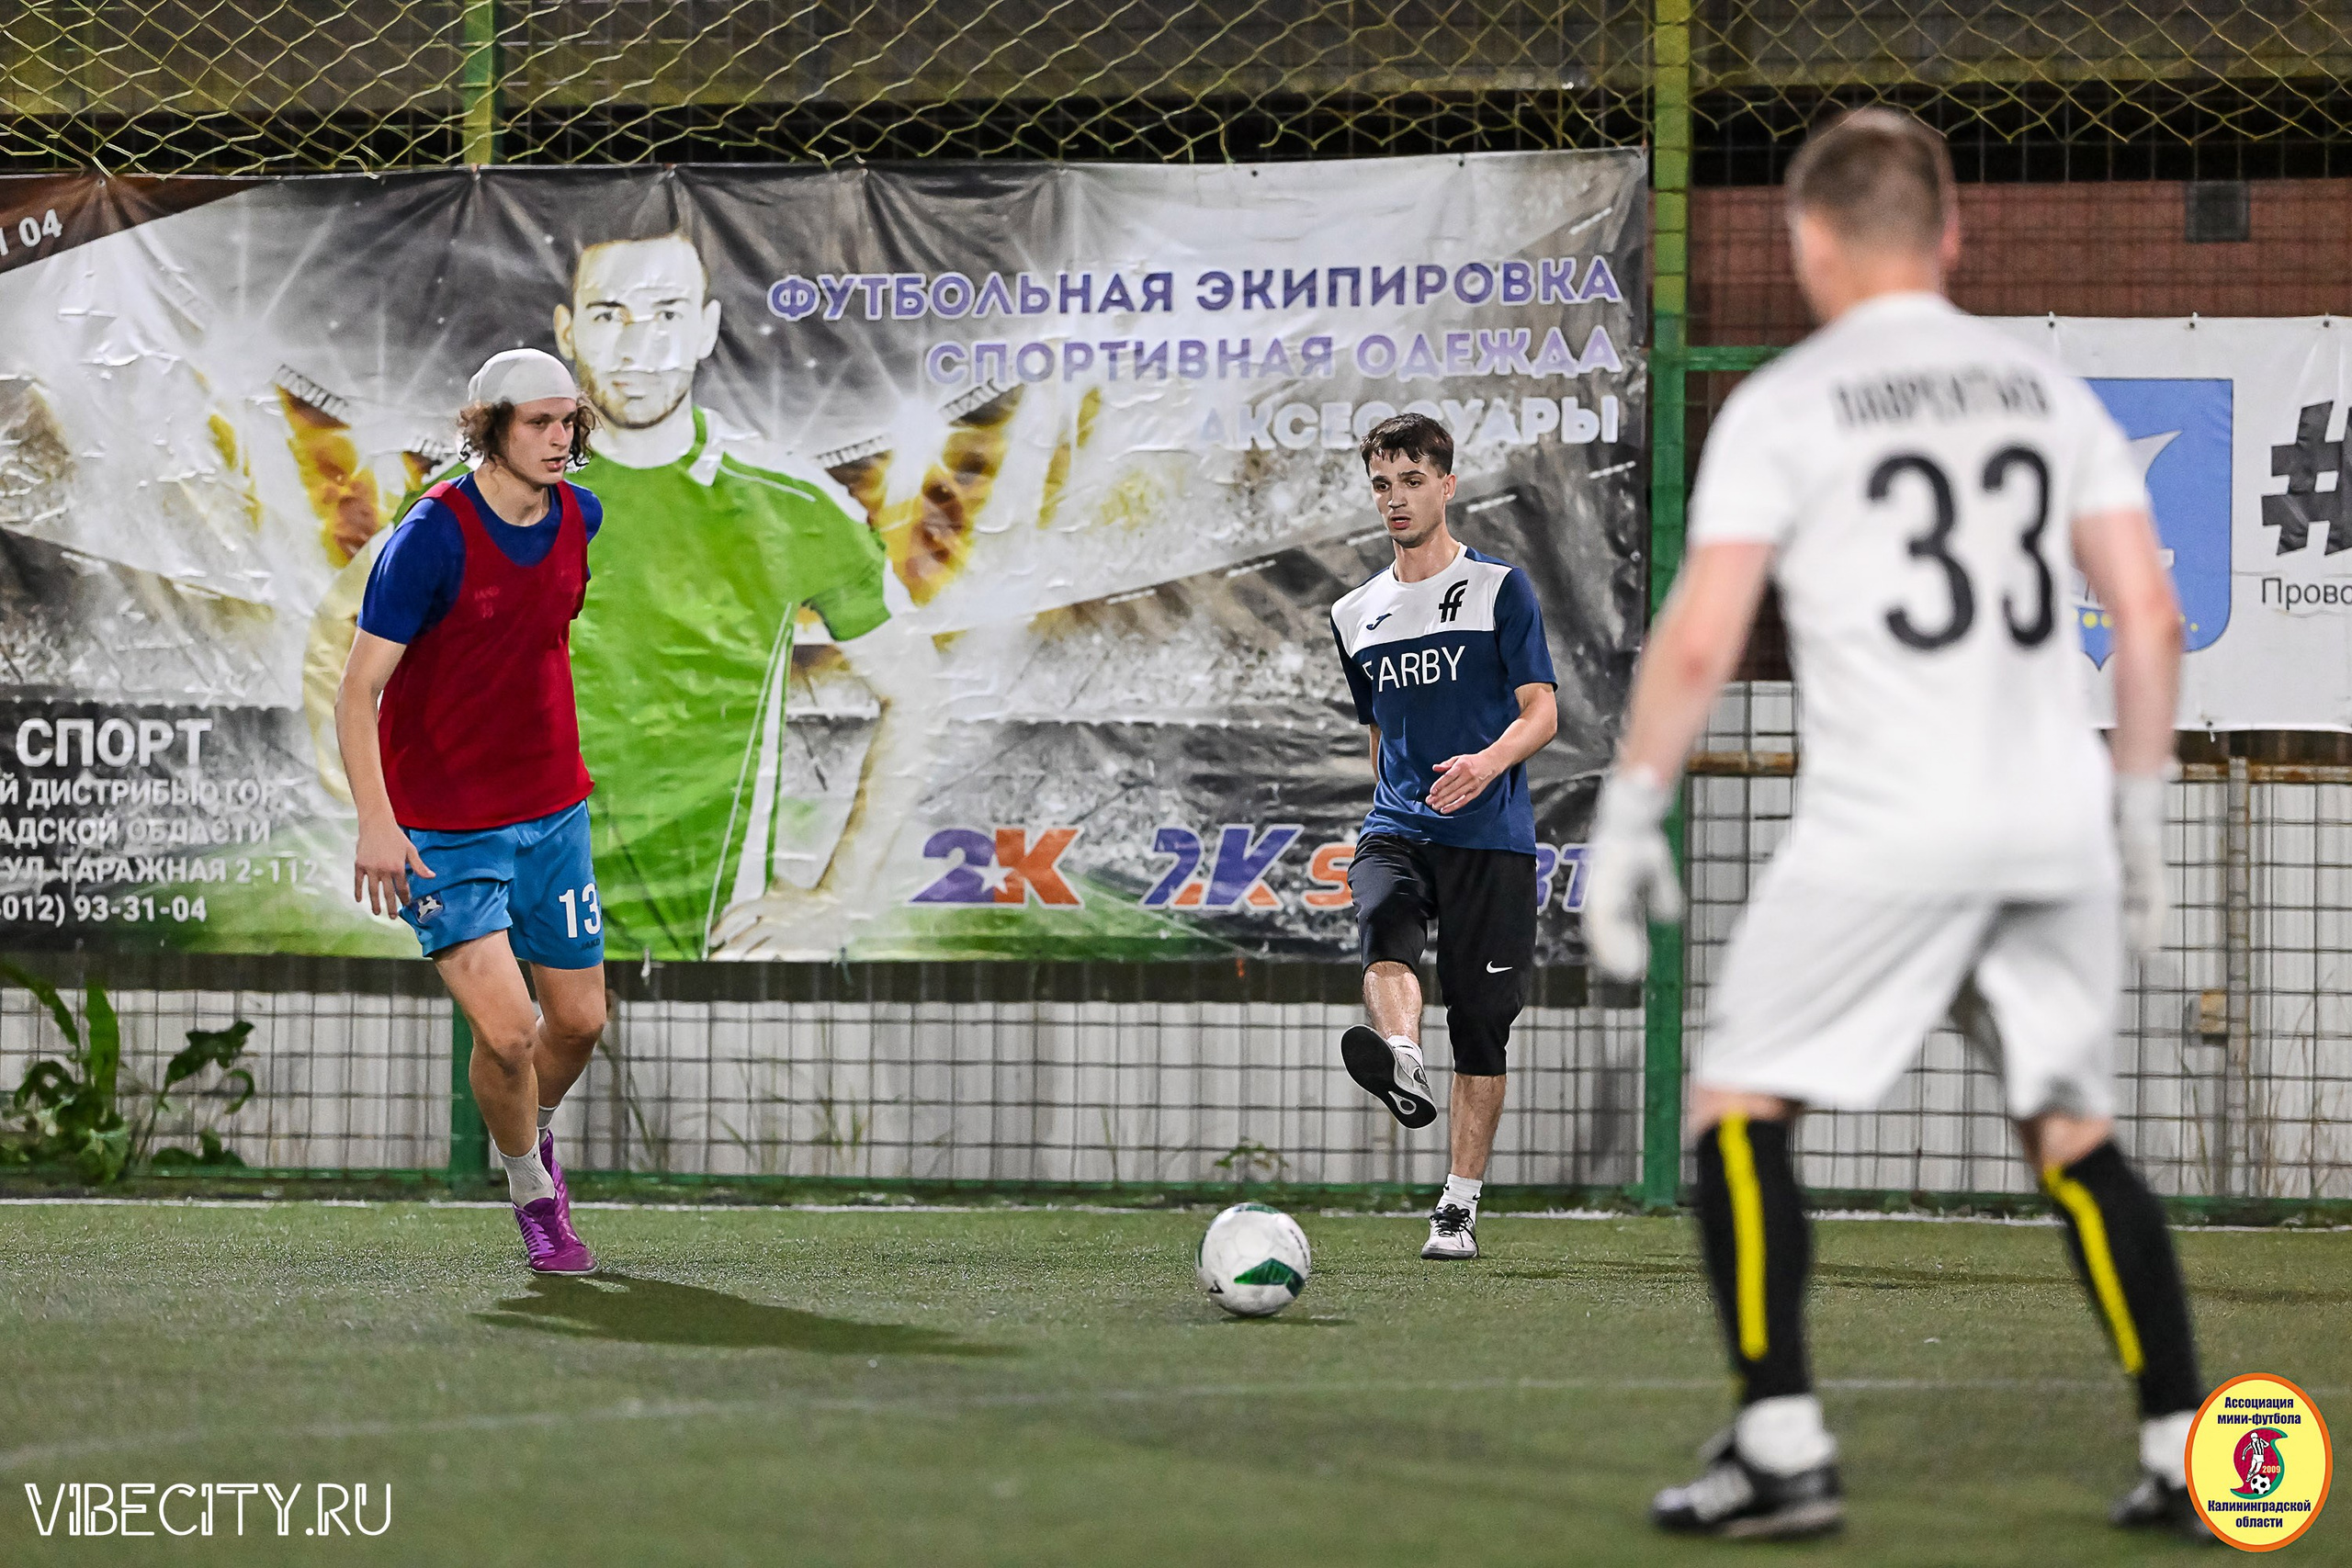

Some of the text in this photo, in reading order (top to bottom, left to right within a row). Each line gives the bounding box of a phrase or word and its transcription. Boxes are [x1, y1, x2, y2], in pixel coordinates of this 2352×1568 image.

[18, 208, 63, 247] 04
[769, 257, 1623, 321] ФУТБОЛЬНАЯ ЭКИПИРОВКА
[926, 326, 1623, 384] СПОРТИВНАЯ ОДЕЖДА
[1866, 442, 2054, 651] 33
[16, 717, 213, 767] СПОРТ
[62, 856, 227, 884] ГАРАЖНАЯ
[908, 826, 1083, 907] 2K
[74, 894, 208, 923] 93-31-04
[559, 883, 601, 939] 13
